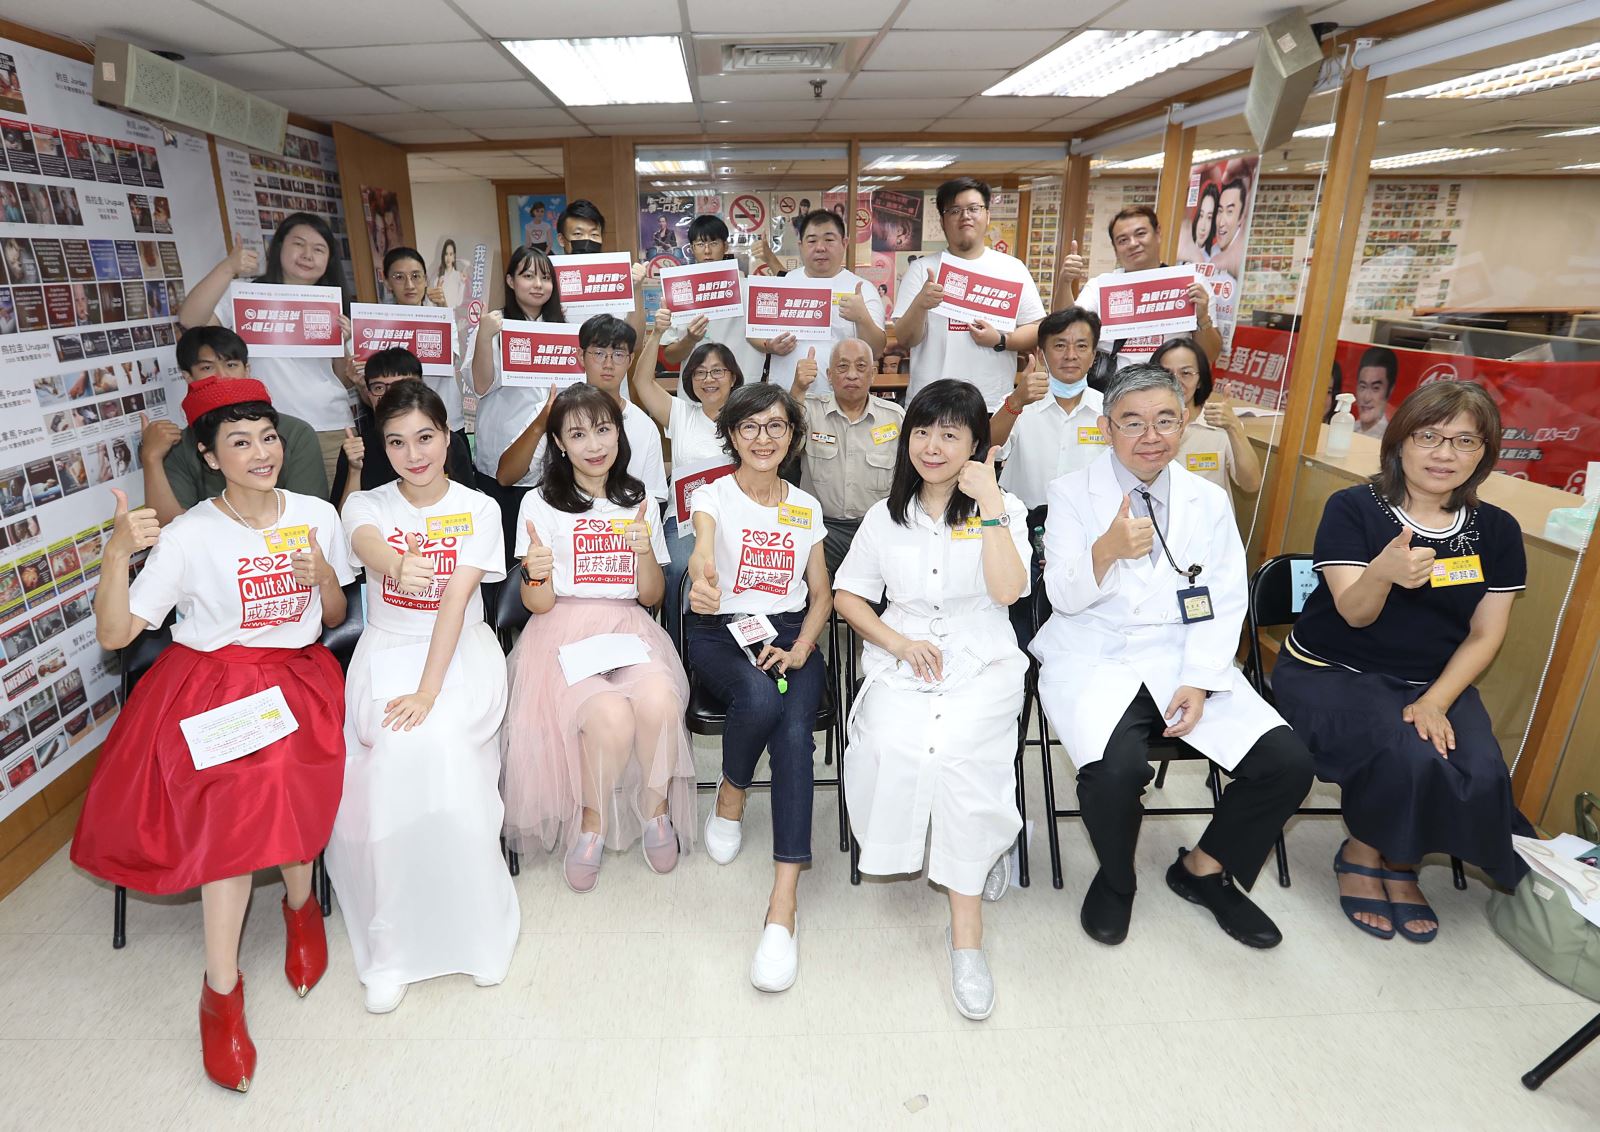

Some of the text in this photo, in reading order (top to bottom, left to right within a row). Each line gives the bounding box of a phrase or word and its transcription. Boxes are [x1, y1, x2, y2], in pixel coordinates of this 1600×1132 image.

[25, 343, 50, 352] Uruguay
[577, 554, 632, 574] 戒菸就贏
[743, 547, 793, 569] Quit&Win
[575, 575, 634, 584] www.e-quit.org
